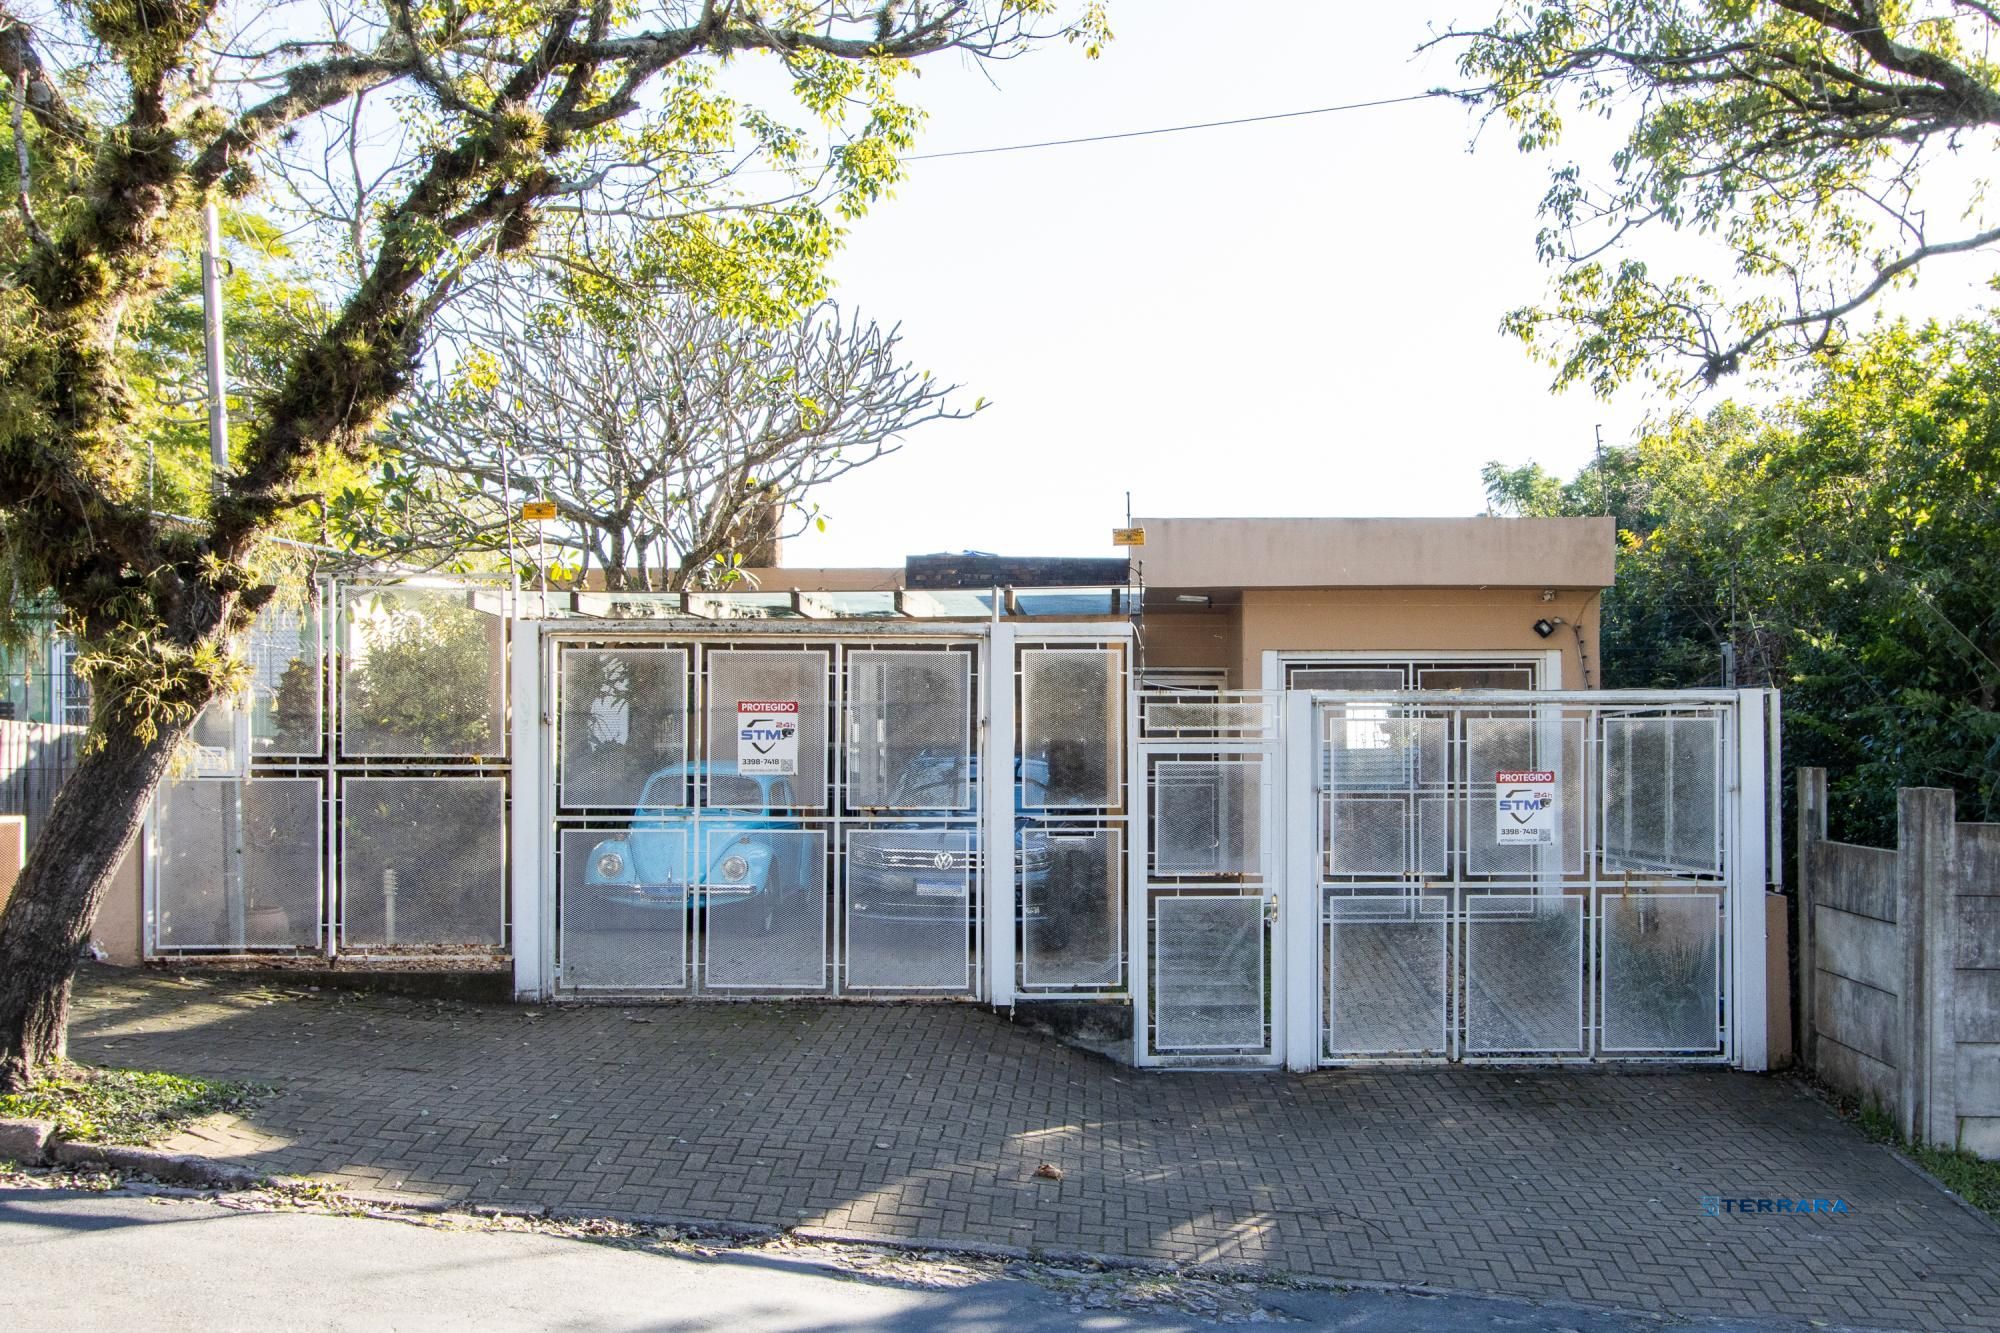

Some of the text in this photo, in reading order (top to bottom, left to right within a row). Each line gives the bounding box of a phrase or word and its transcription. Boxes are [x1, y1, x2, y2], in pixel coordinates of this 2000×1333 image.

[742, 703, 795, 711] PROTEGIDO
[741, 730, 781, 740] STM
[1500, 773, 1551, 782] PROTEGIDO
[1500, 800, 1539, 810] STM
